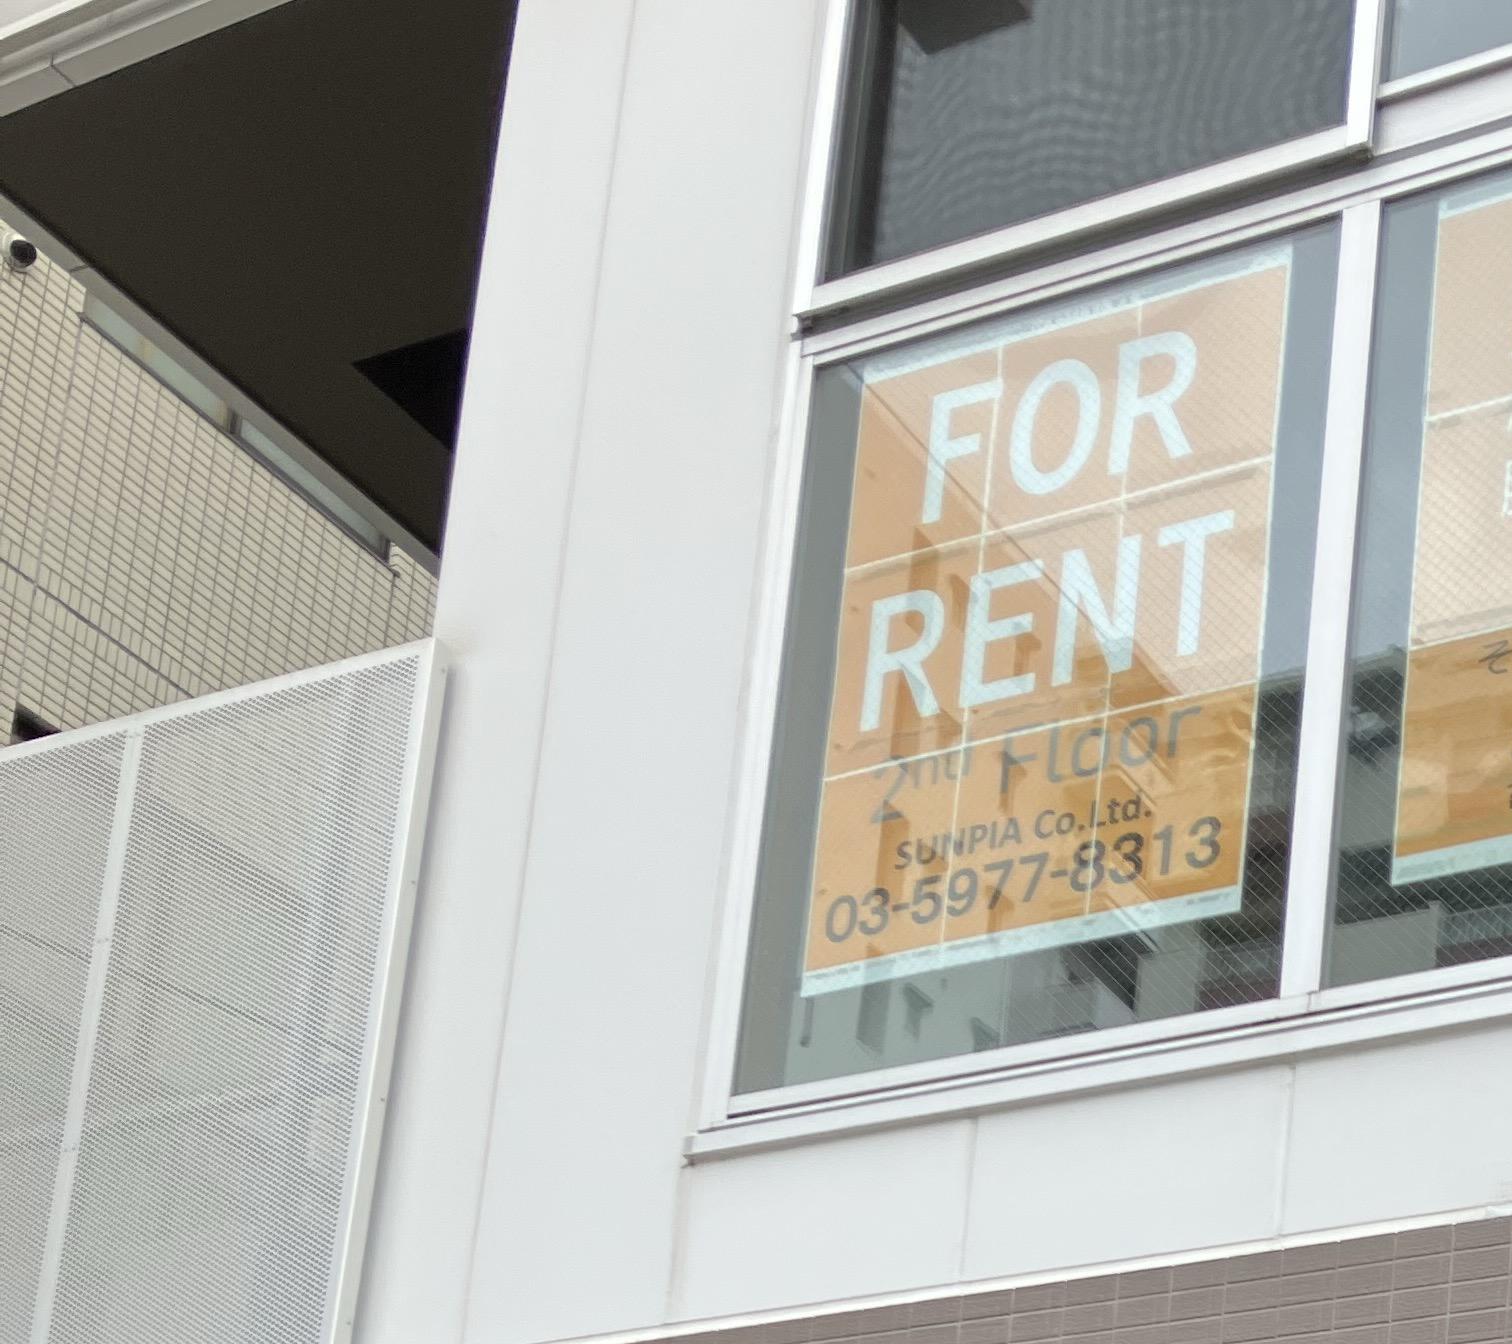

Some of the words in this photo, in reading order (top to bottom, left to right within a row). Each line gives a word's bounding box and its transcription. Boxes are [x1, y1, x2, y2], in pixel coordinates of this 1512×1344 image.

[922, 331, 1198, 524] FOR
[860, 509, 1235, 733] RENT
[1000, 704, 1202, 798] Floor
[825, 816, 1223, 945] 03-5977-8313
[894, 818, 1022, 871] SUNPIA
